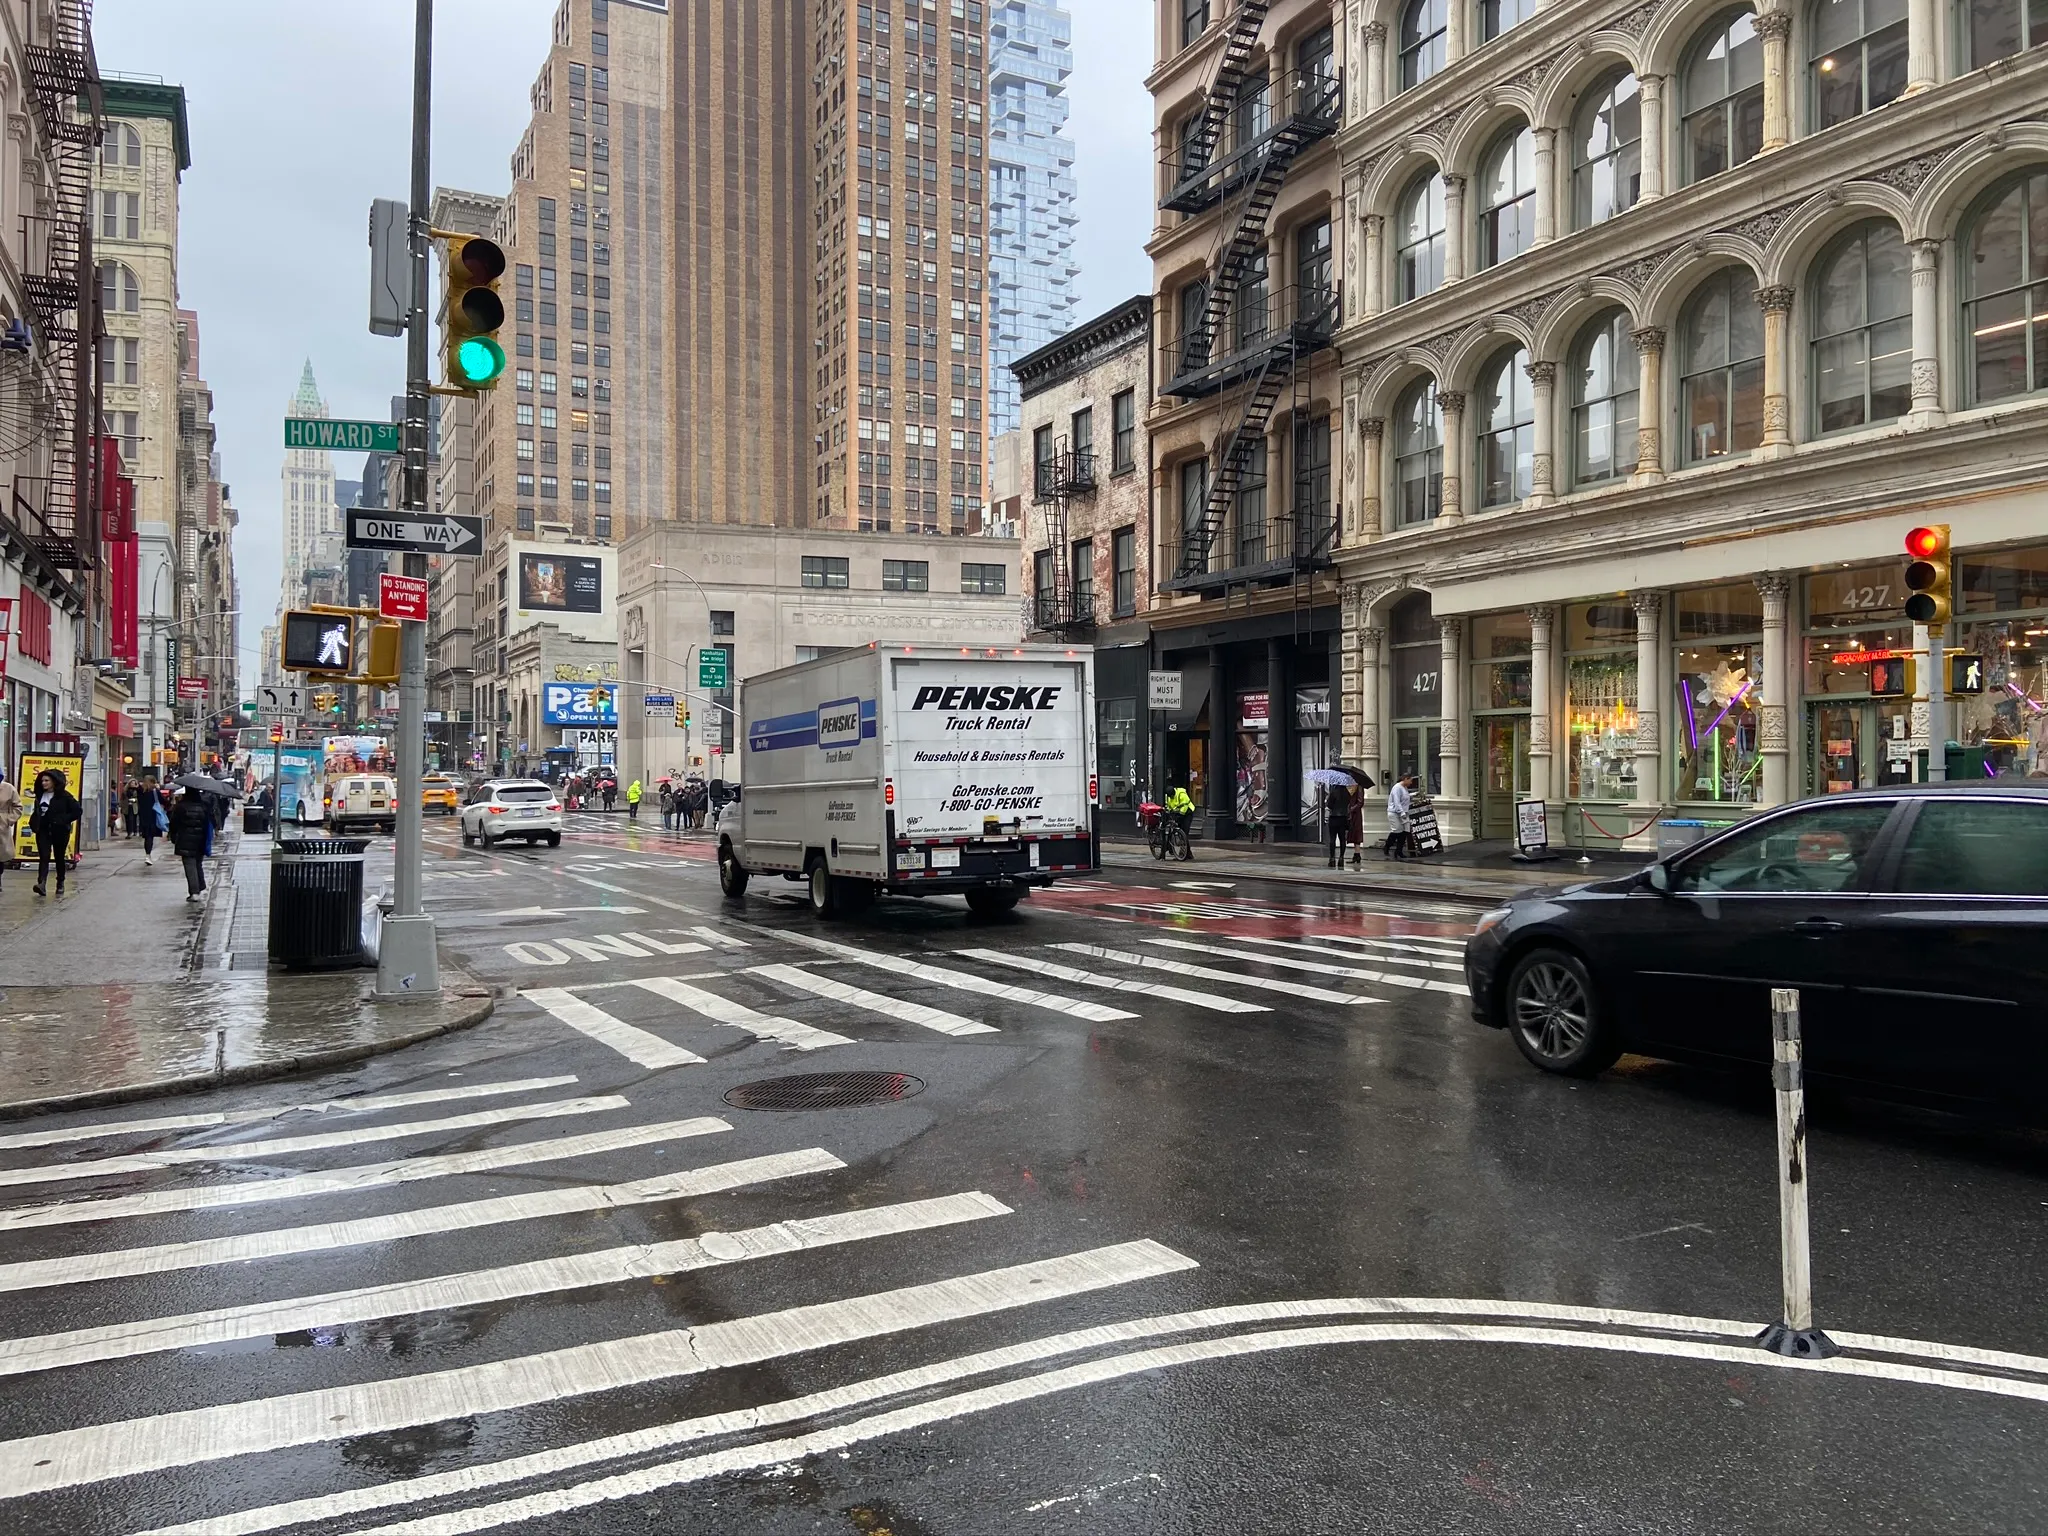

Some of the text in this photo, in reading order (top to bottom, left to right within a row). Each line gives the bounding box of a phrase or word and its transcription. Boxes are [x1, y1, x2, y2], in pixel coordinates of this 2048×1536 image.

[290, 421, 394, 448] HOWARD ST
[367, 522, 462, 543] ONE WAY
[383, 578, 425, 593] NO STANDING
[388, 591, 421, 603] ANYTIME
[1842, 585, 1890, 609] 427
[1833, 652, 1871, 662] BROADWAY
[1412, 672, 1438, 692] 427
[1156, 686, 1174, 694] MUST
[912, 686, 1062, 711] PENSKE
[1301, 703, 1316, 713] STEVE
[821, 713, 857, 734] PENSKE
[945, 716, 1032, 731] Truck Rental
[825, 750, 854, 764] Truck Rental
[913, 749, 1065, 762] Household & Business Rentals
[952, 784, 1034, 797] GoPenske.com
[939, 796, 1043, 812] 1-800-GO-PENSKE
[1416, 828, 1437, 839] VINTAGE
[502, 926, 752, 966] ONLY
